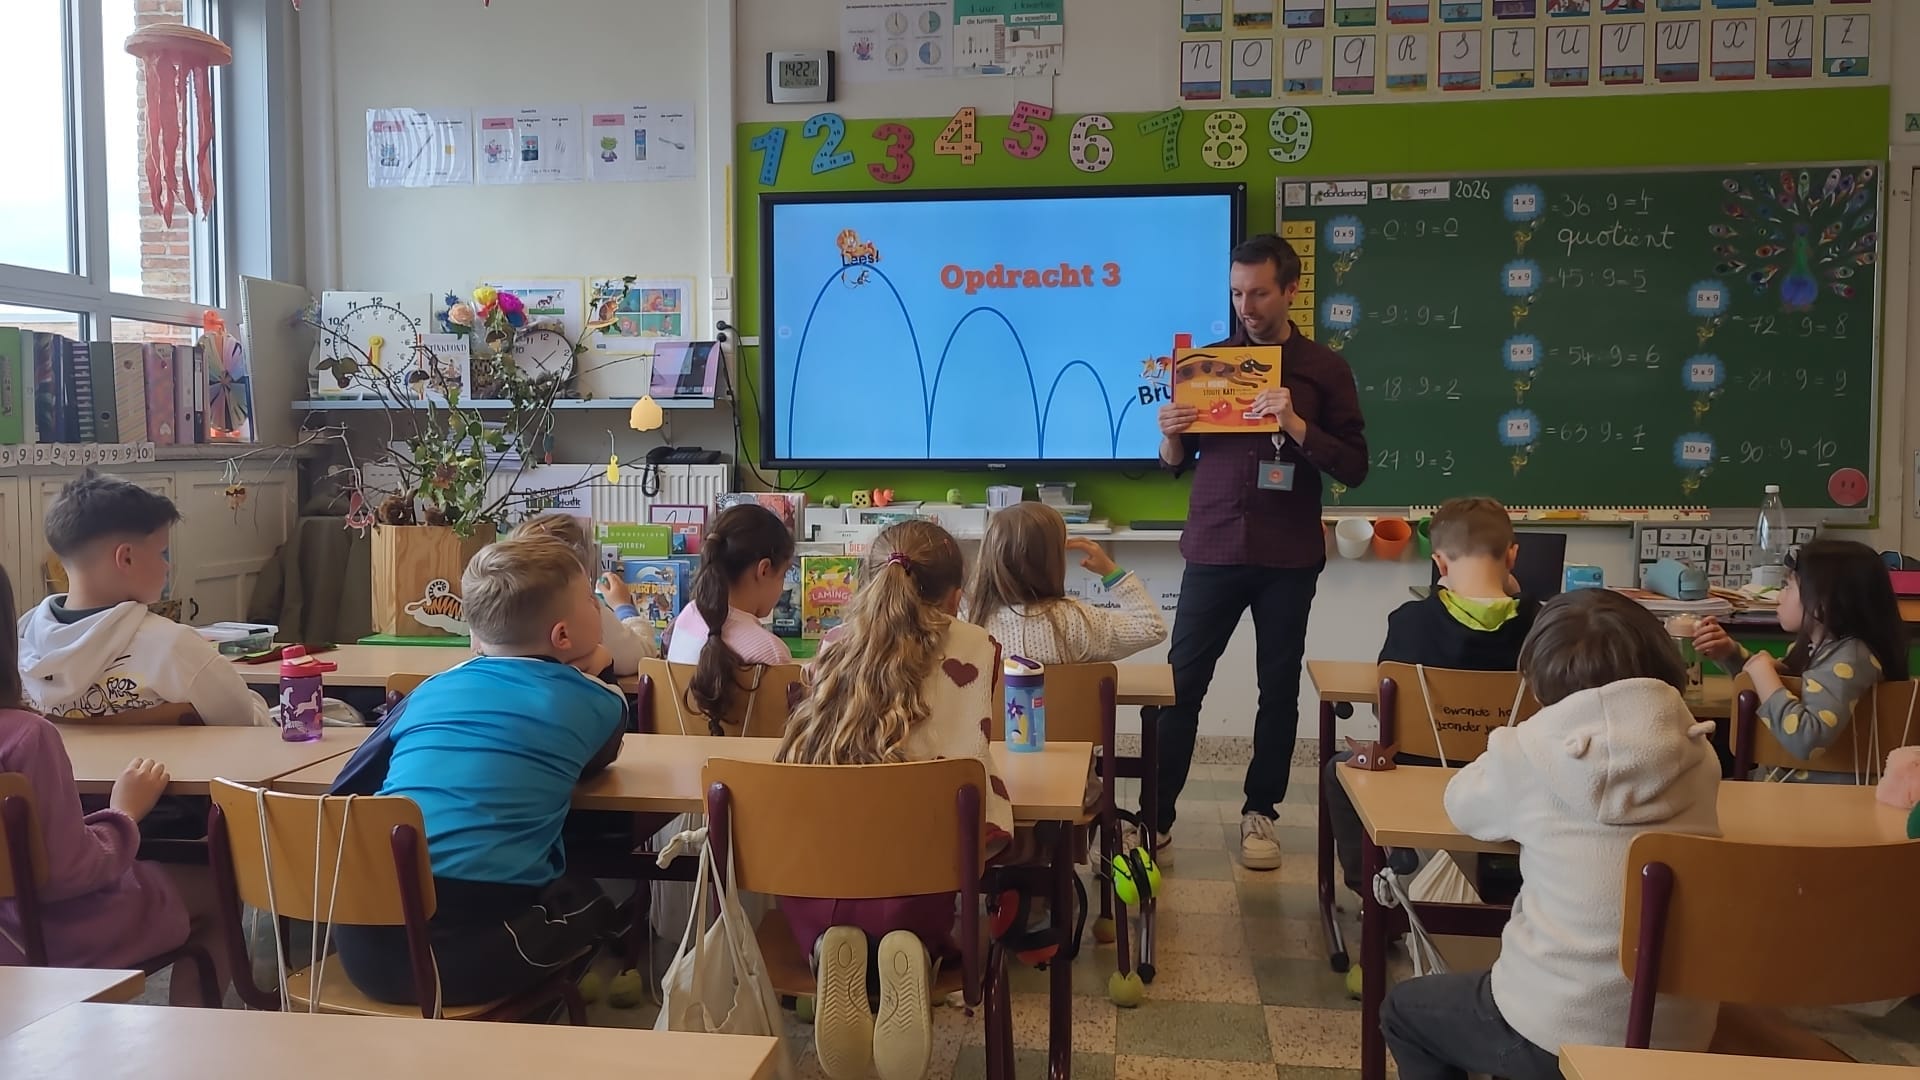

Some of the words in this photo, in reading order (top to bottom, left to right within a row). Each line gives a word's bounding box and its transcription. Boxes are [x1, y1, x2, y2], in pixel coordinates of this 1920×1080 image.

[1242, 41, 1263, 67] O
[1399, 34, 1417, 62] R
[934, 106, 982, 166] 4
[1003, 100, 1053, 160] 5
[1137, 106, 1184, 172] 7
[1200, 110, 1249, 170] 8
[1268, 106, 1313, 163] 9
[803, 112, 856, 176] 2
[867, 123, 915, 184] 3
[1068, 113, 1114, 173] 6
[751, 126, 786, 186] 1
[1323, 188, 1366, 200] donderdag
[1418, 187, 1437, 196] april
[1454, 180, 1490, 199] 2026
[1563, 196, 1590, 216] 36
[1606, 193, 1617, 210] 9
[1383, 220, 1400, 238] 0
[1416, 220, 1425, 236] 9
[1444, 218, 1458, 234] 0
[1558, 222, 1675, 256] quotient
[841, 250, 880, 266] Lees!
[940, 262, 1094, 294] Opdracht
[1102, 262, 1121, 287] 3
[1603, 269, 1616, 287] 9
[1634, 269, 1647, 288] 5
[371, 297, 383, 306] 12
[1304, 296, 1309, 305] 6
[1302, 314, 1307, 322] 5
[1382, 305, 1398, 323] 9
[1418, 306, 1430, 324] 9
[1450, 307, 1458, 324] 1
[1750, 316, 1777, 336] 72
[1801, 316, 1813, 336] 9
[1836, 314, 1848, 334] 8
[540, 333, 549, 341] 12
[1569, 346, 1592, 366] 54
[1610, 346, 1623, 367] 9
[1647, 344, 1660, 364] 6
[1416, 377, 1429, 394] 9
[1447, 378, 1459, 396] 2
[1796, 368, 1807, 390] 9
[1835, 370, 1847, 391] 9
[1560, 421, 1587, 440] 63
[1600, 421, 1611, 442] 9
[1633, 423, 1645, 444] 7
[1415, 450, 1425, 468] 9
[1443, 451, 1455, 471] 3
[1740, 441, 1763, 463] 90
